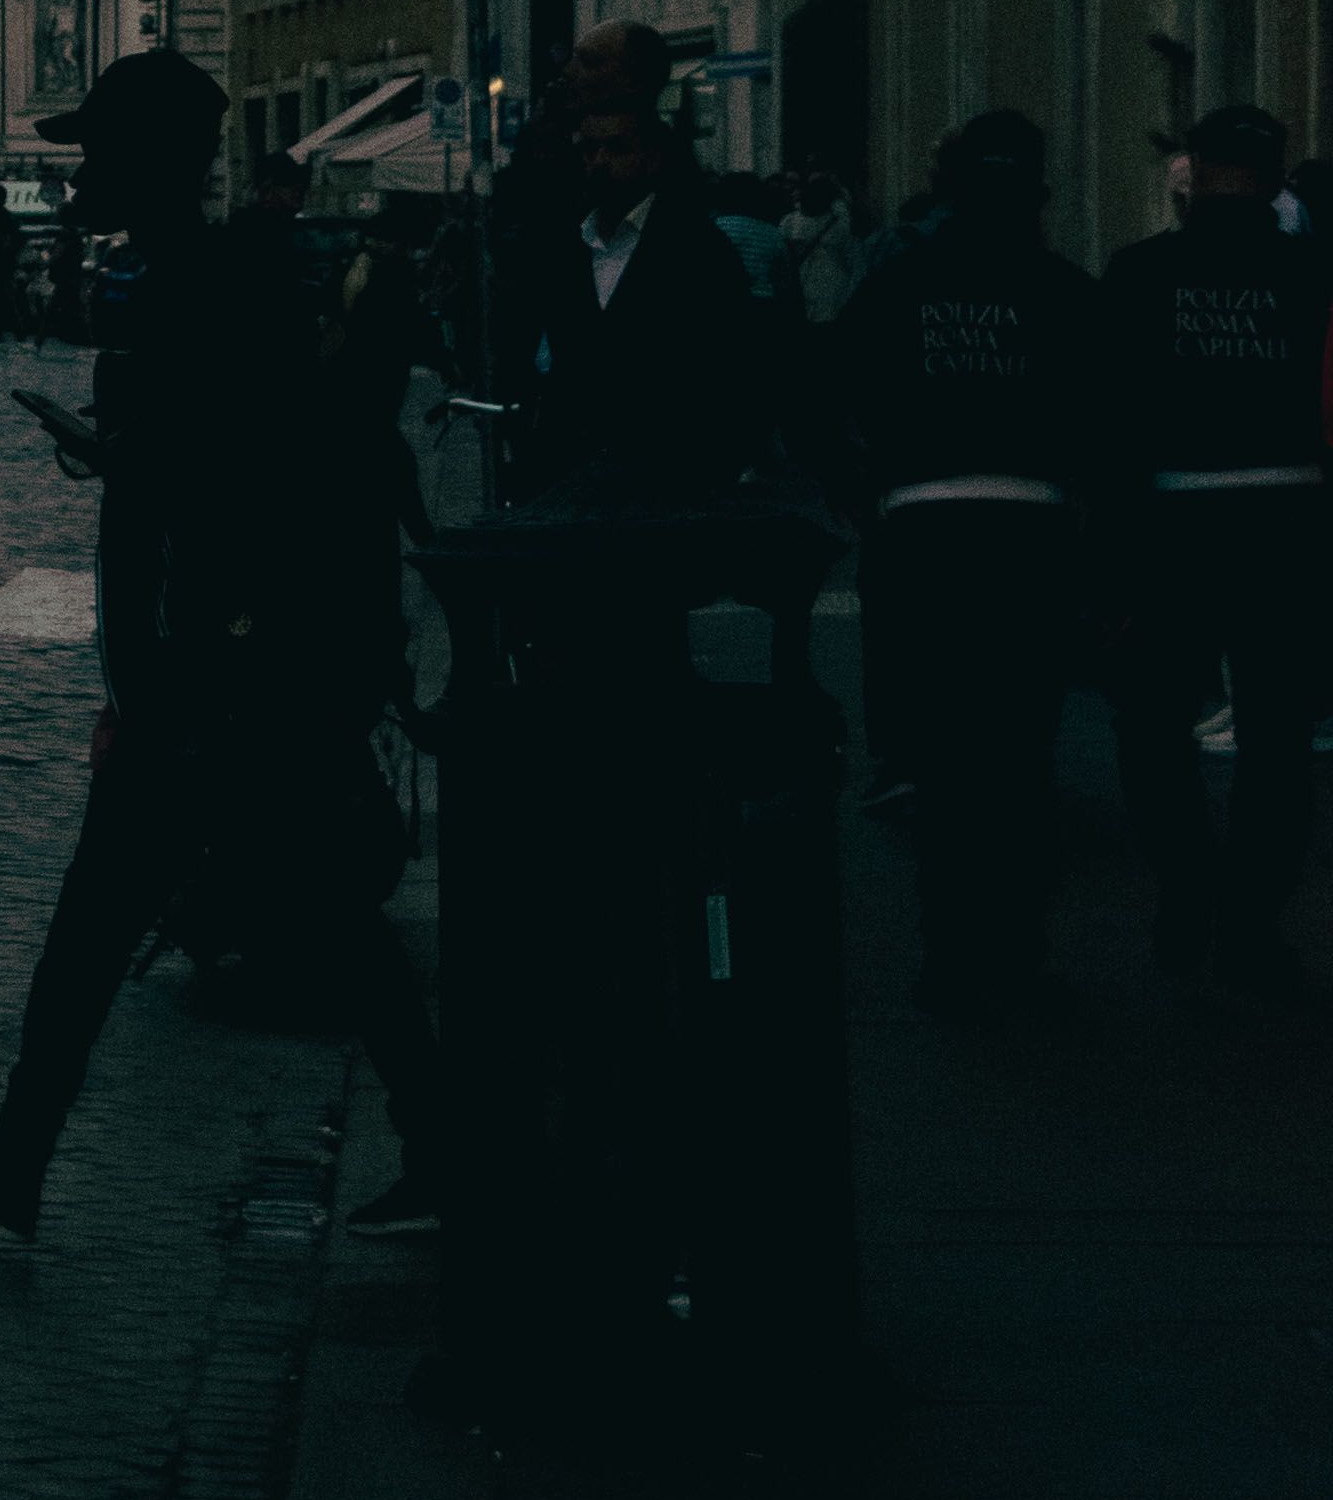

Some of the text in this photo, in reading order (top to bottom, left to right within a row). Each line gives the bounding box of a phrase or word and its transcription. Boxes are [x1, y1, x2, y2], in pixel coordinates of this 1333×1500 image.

[1175, 287, 1278, 310] POLIZIA
[920, 301, 1019, 326] POLIZIA
[1175, 311, 1258, 334] ROMA
[923, 326, 998, 351] ROMA
